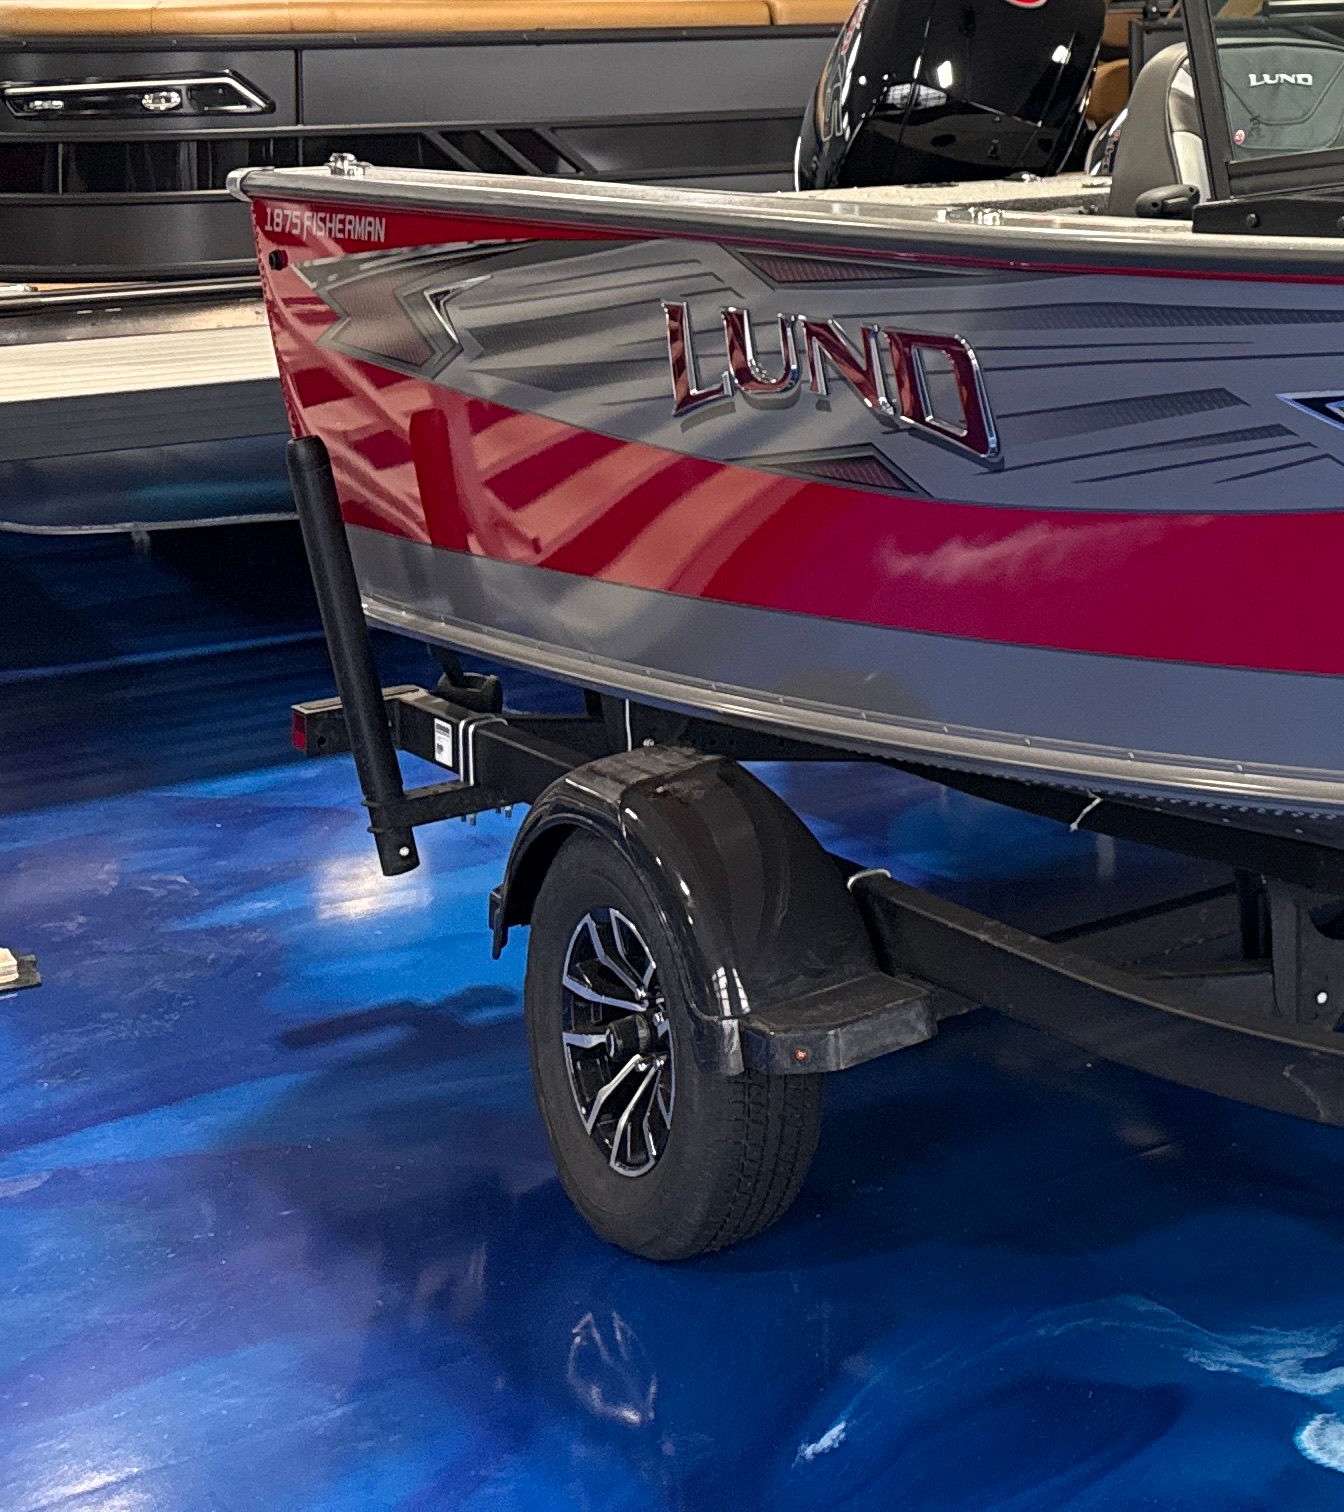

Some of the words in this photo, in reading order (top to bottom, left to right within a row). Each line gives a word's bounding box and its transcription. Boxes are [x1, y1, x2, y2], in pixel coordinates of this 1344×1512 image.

[1248, 73, 1314, 87] LUND
[264, 207, 301, 236] 1875
[303, 211, 386, 244] FISHERMAN
[660, 297, 1001, 460] LUND
